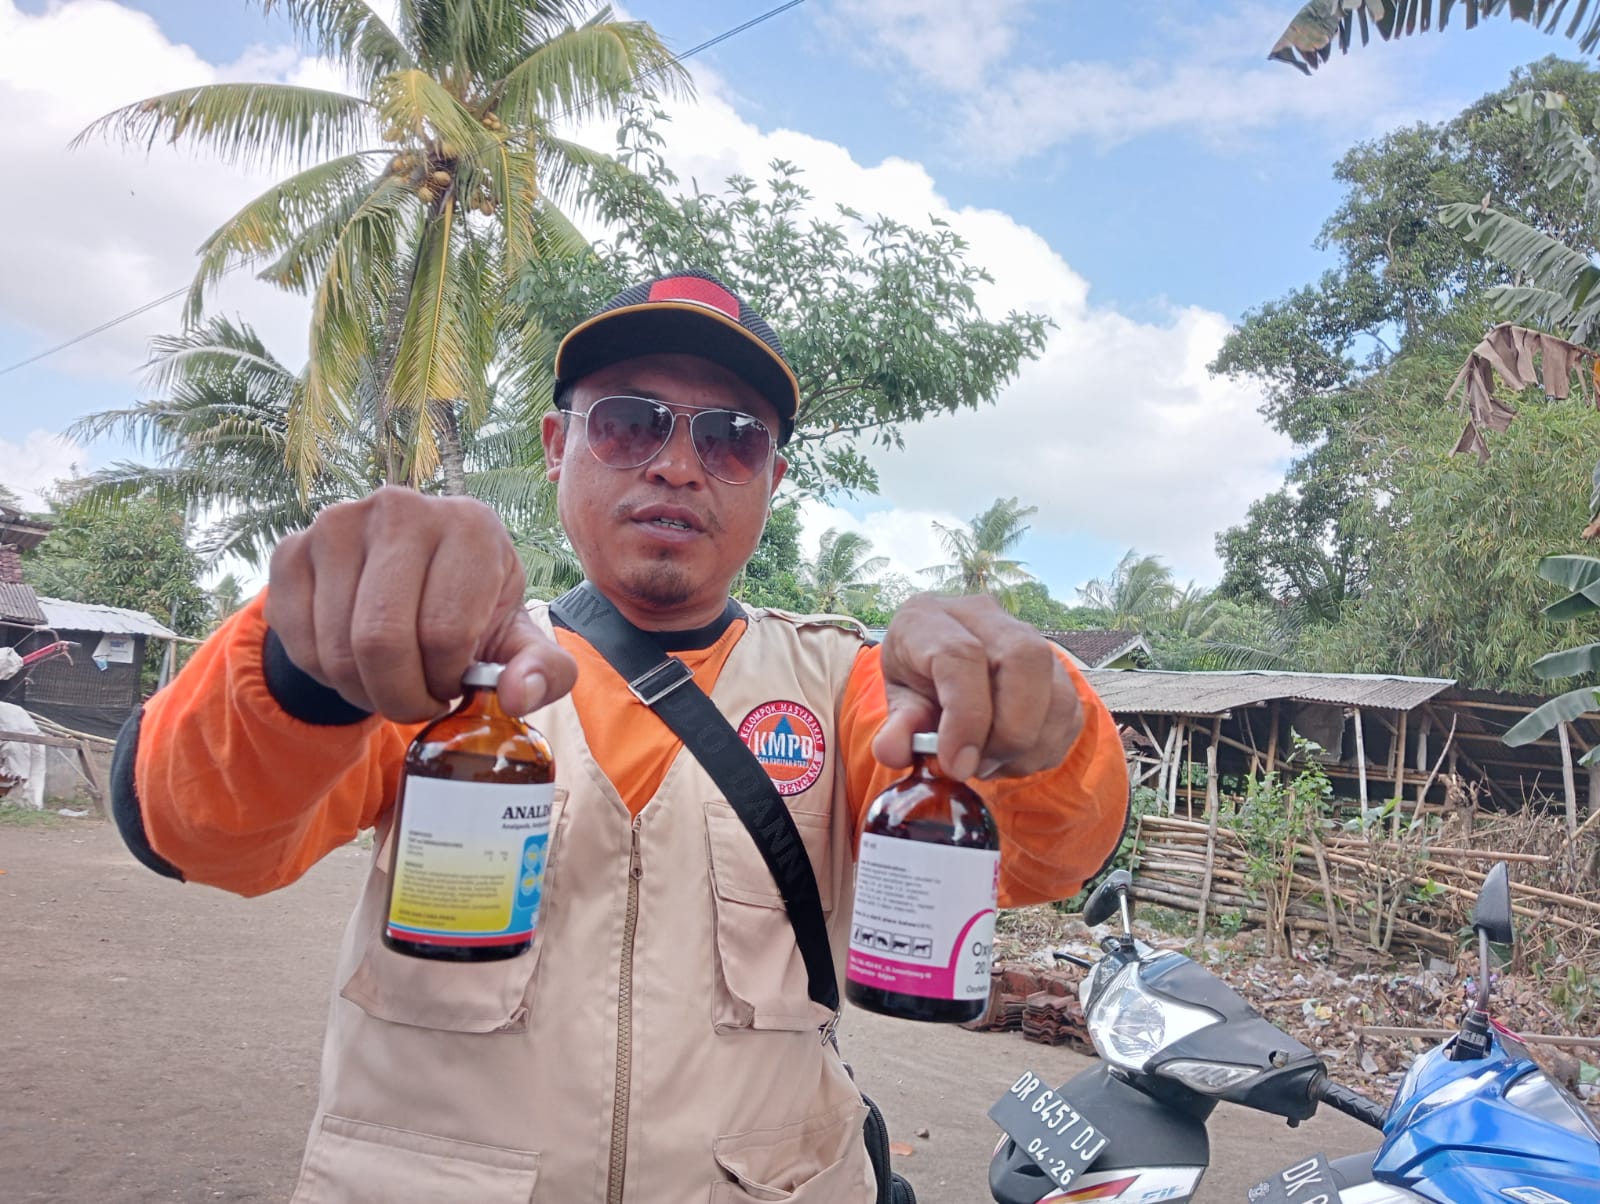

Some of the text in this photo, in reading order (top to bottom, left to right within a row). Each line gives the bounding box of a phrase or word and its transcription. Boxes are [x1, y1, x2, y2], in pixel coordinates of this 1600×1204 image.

[740, 705, 776, 738] KELOMPOK
[781, 704, 823, 744] MASYARAKAT
[779, 761, 821, 794] BENCANA
[501, 804, 552, 819] ANALD
[1011, 1071, 1106, 1160] DR 6457 DJ
[1282, 1158, 1322, 1197] DK
